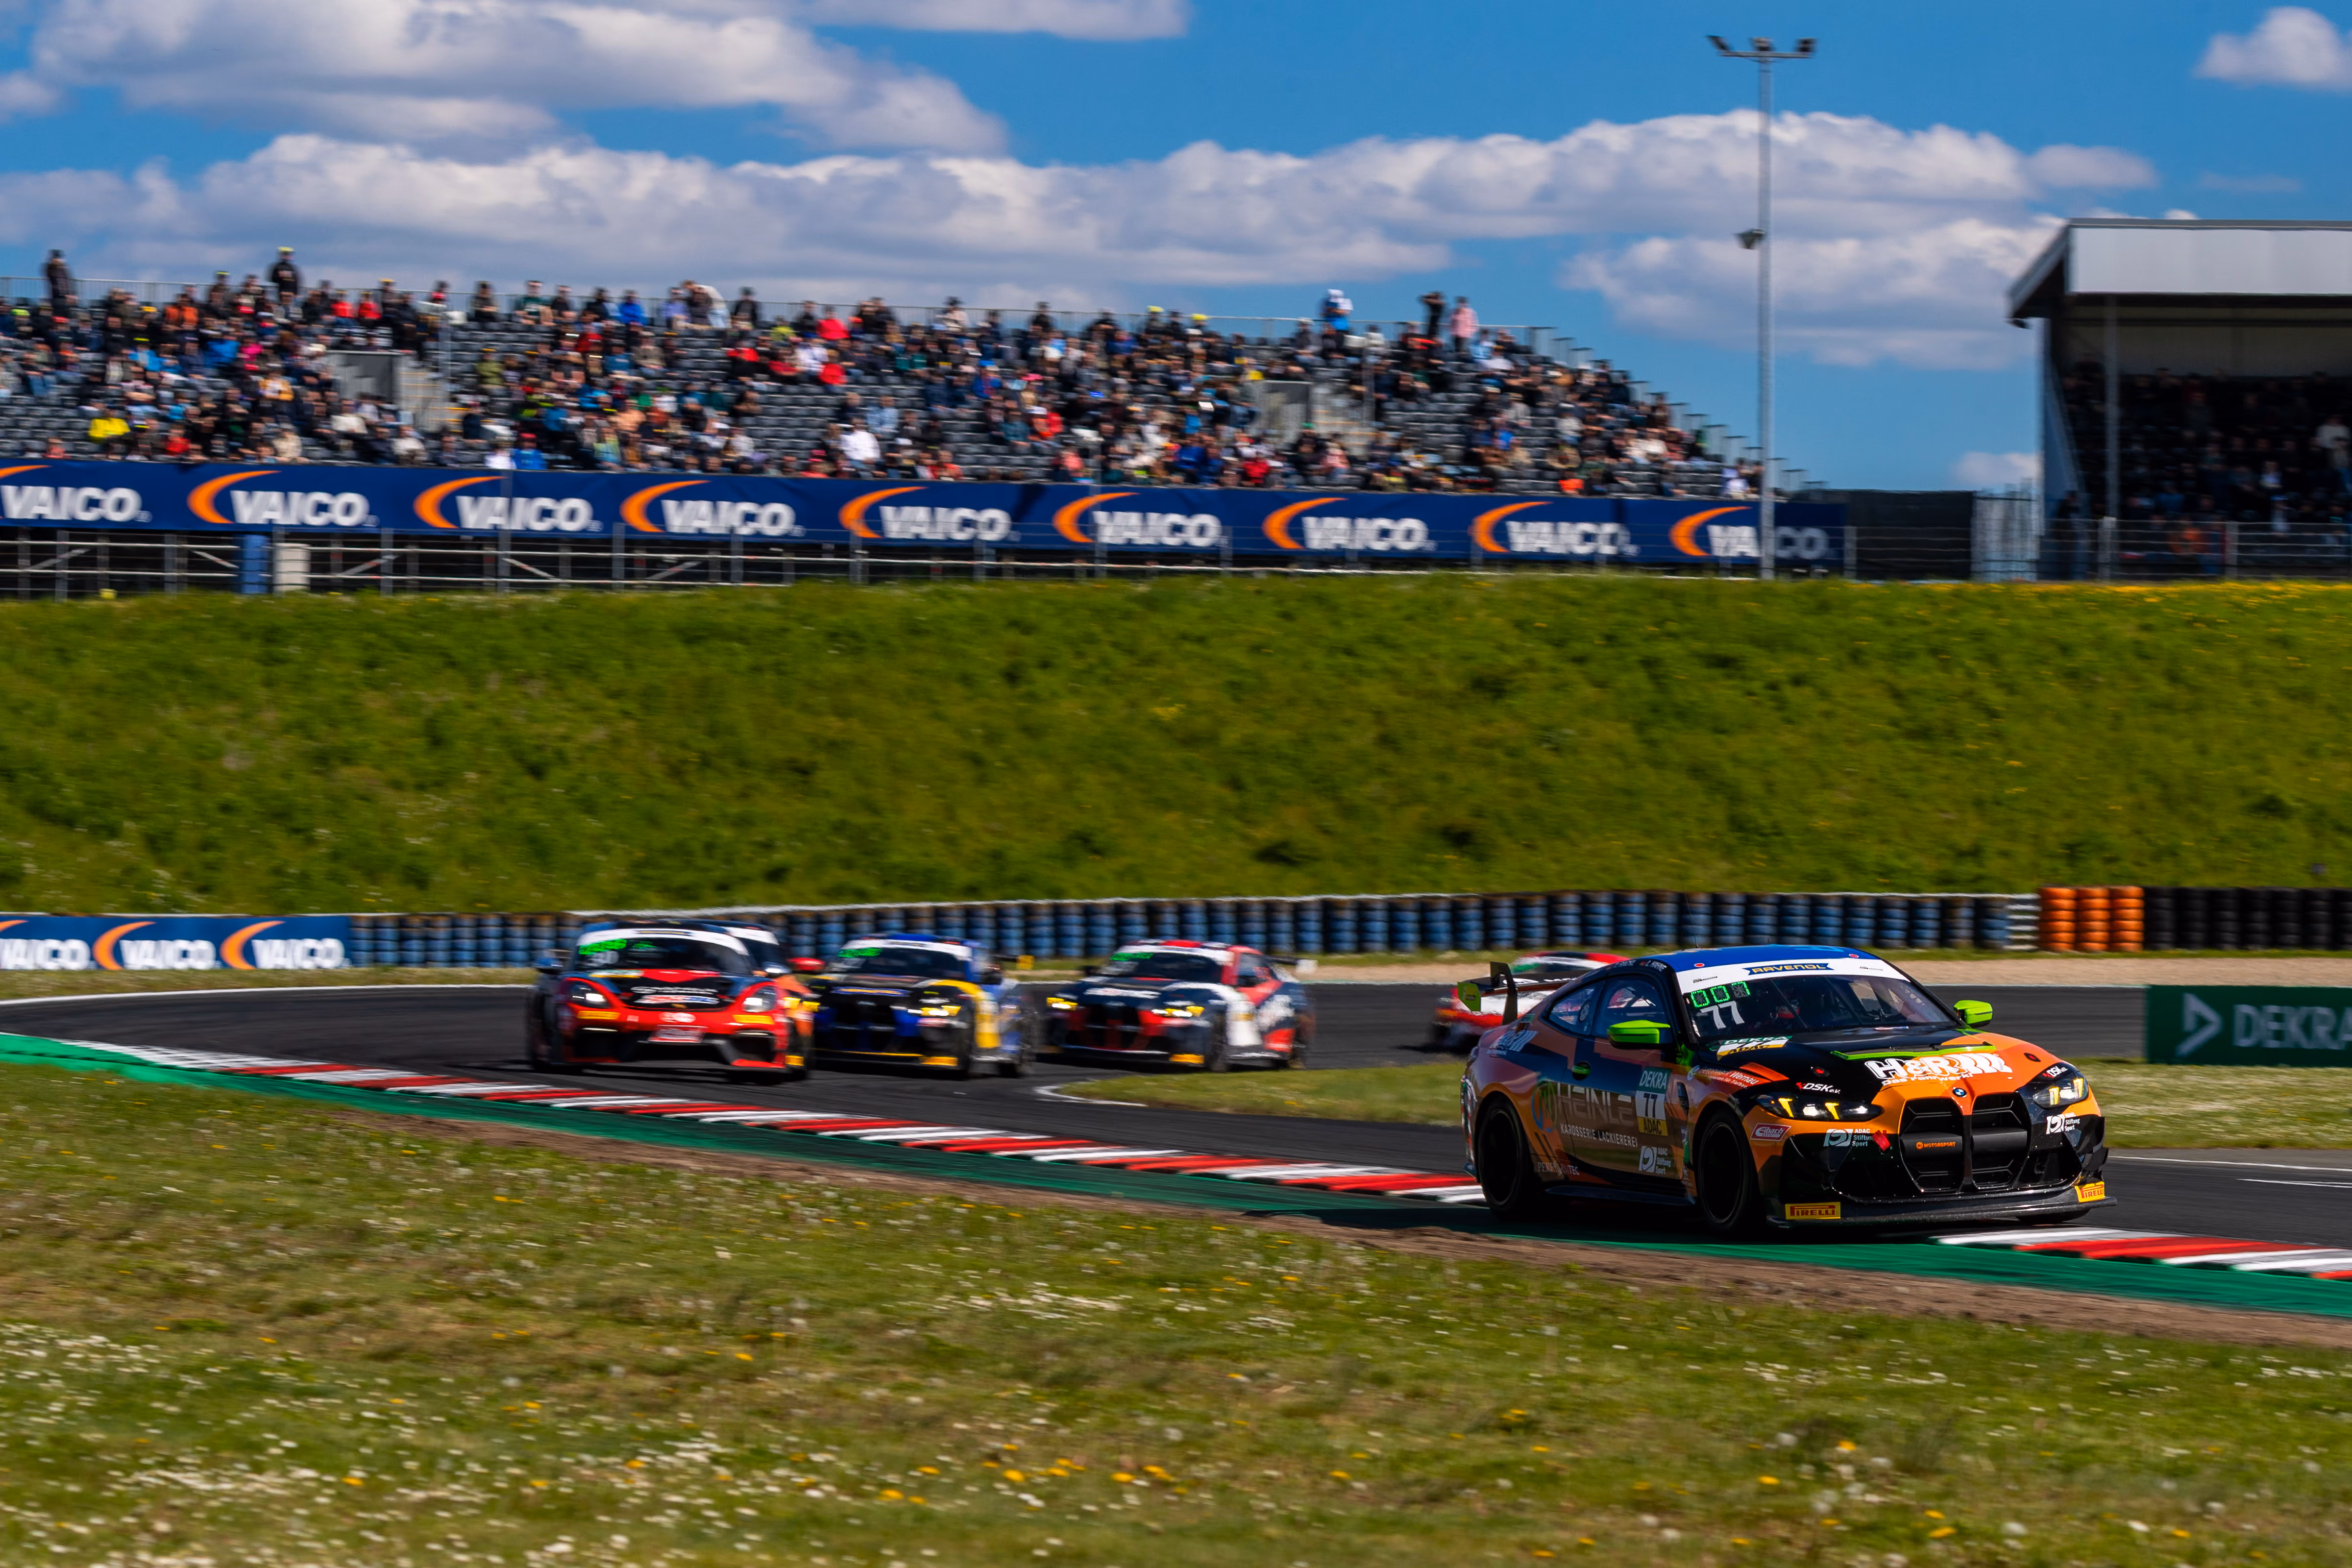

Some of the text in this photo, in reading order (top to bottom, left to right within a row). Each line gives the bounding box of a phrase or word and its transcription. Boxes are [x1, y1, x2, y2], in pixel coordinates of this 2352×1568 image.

[0, 485, 142, 521] VAICO
[230, 490, 369, 526] VAICO
[456, 496, 592, 531] VAICO
[661, 499, 795, 536] VAICO
[879, 506, 1012, 541] VAICO
[1093, 511, 1221, 547] VAICO
[1301, 517, 1428, 551] VAICO
[1505, 521, 1631, 554] VAICO
[1707, 524, 1829, 560] VACO
[0, 938, 91, 970] VAICO
[120, 939, 216, 970] VAICO
[251, 938, 344, 969] VAICO
[1752, 964, 1826, 973] RAVENOL
[1700, 1001, 1745, 1029] 77
[1724, 1036, 1787, 1045] DEKRA
[1639, 1071, 1667, 1089] DEKRA
[1729, 1071, 1760, 1085] Wernau
[2046, 1066, 2061, 1077] DSK
[1803, 1083, 1833, 1092] DSK
[1643, 1093, 1658, 1118] 77
[1560, 1123, 1638, 1148] KAROSSERIE LACKIEREREI
[1643, 1119, 1662, 1134] ADAC
[1790, 1205, 1836, 1216] PIRELLI
